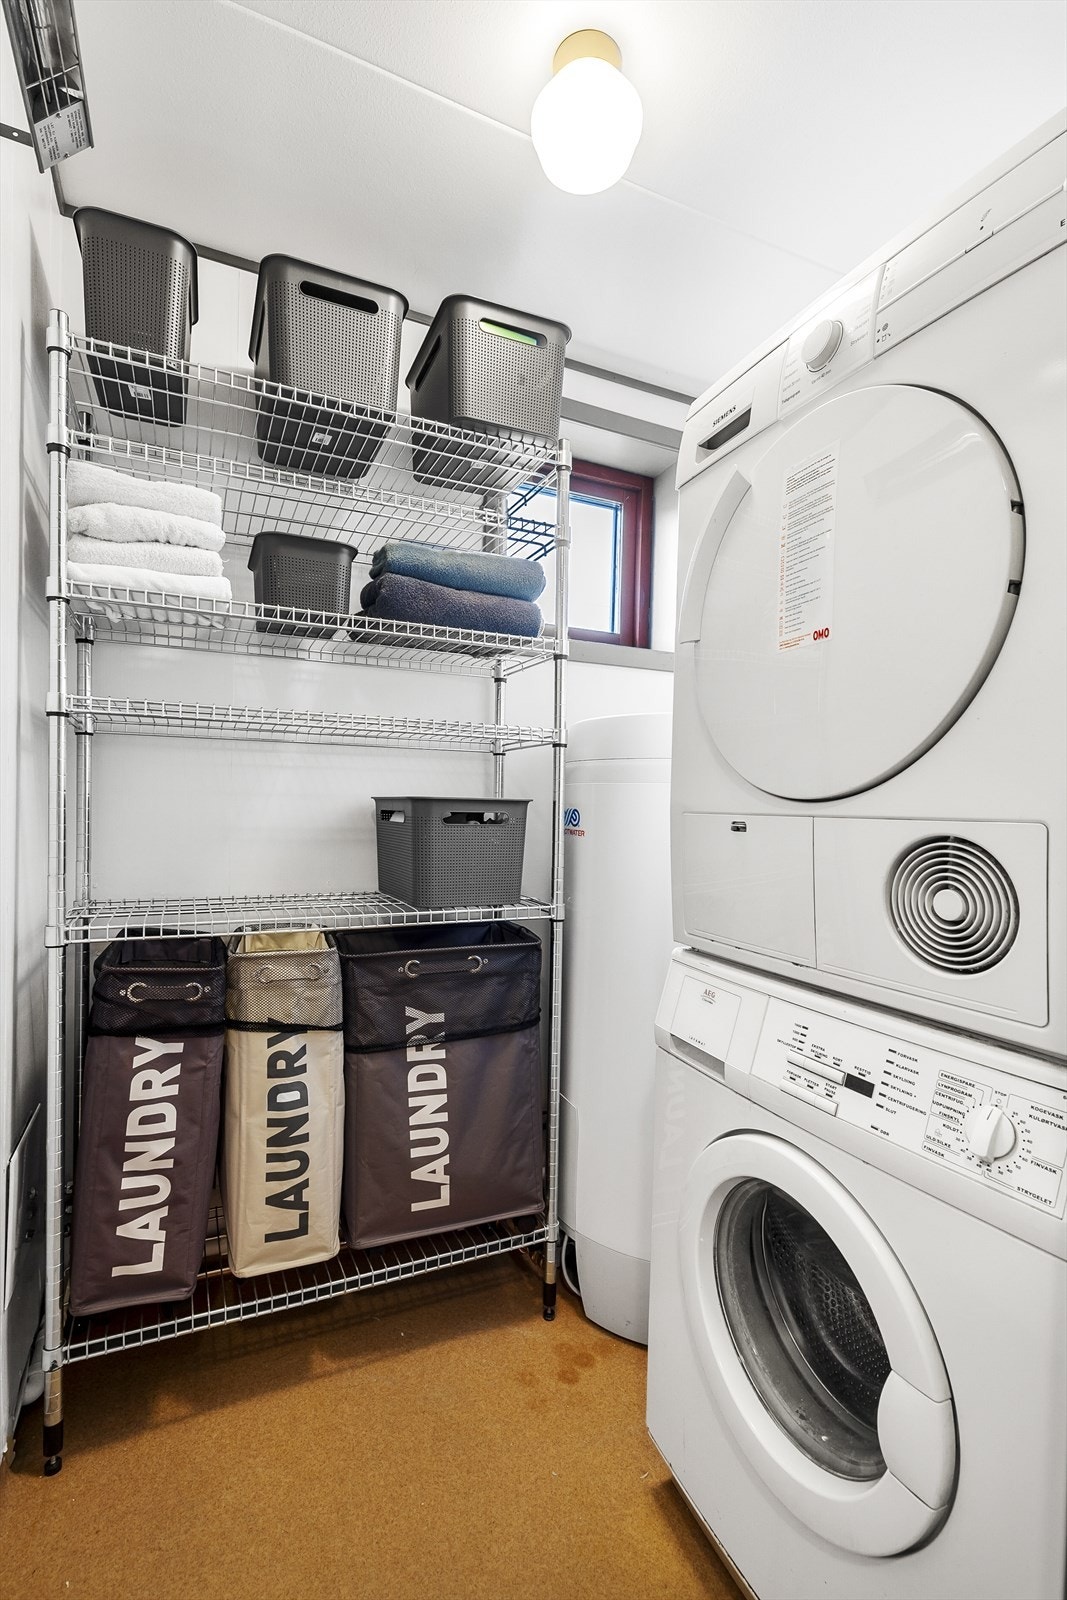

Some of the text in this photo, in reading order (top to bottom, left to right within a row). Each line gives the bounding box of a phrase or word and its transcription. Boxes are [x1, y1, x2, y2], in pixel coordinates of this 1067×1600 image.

[712, 404, 736, 428] SIEMENS
[813, 628, 830, 640] OMO
[704, 988, 716, 998] AEG
[897, 1052, 918, 1063] FORVASK
[854, 1066, 872, 1076] RESTTID
[896, 1063, 920, 1076] KLARVASK
[826, 1082, 838, 1090] START
[940, 1072, 976, 1089] ENERGISPARE
[824, 1087, 836, 1095] PAUSE
[937, 1082, 973, 1098] LYNPROGRAM
[404, 1005, 450, 1213] LAUNDRY
[887, 1096, 927, 1116] CENTRIFUGERING
[932, 1100, 966, 1117] UDPUMPNING
[1030, 1105, 1064, 1121] KOGEVASK
[264, 1017, 309, 1244] LAUNDRY
[942, 1123, 960, 1134] KOLDT
[111, 1035, 185, 1278] LAUNDRY
[923, 1144, 945, 1158] FINVASK
[1030, 1160, 1058, 1176] FINVASK
[1016, 1186, 1053, 1206] STRYGELET
